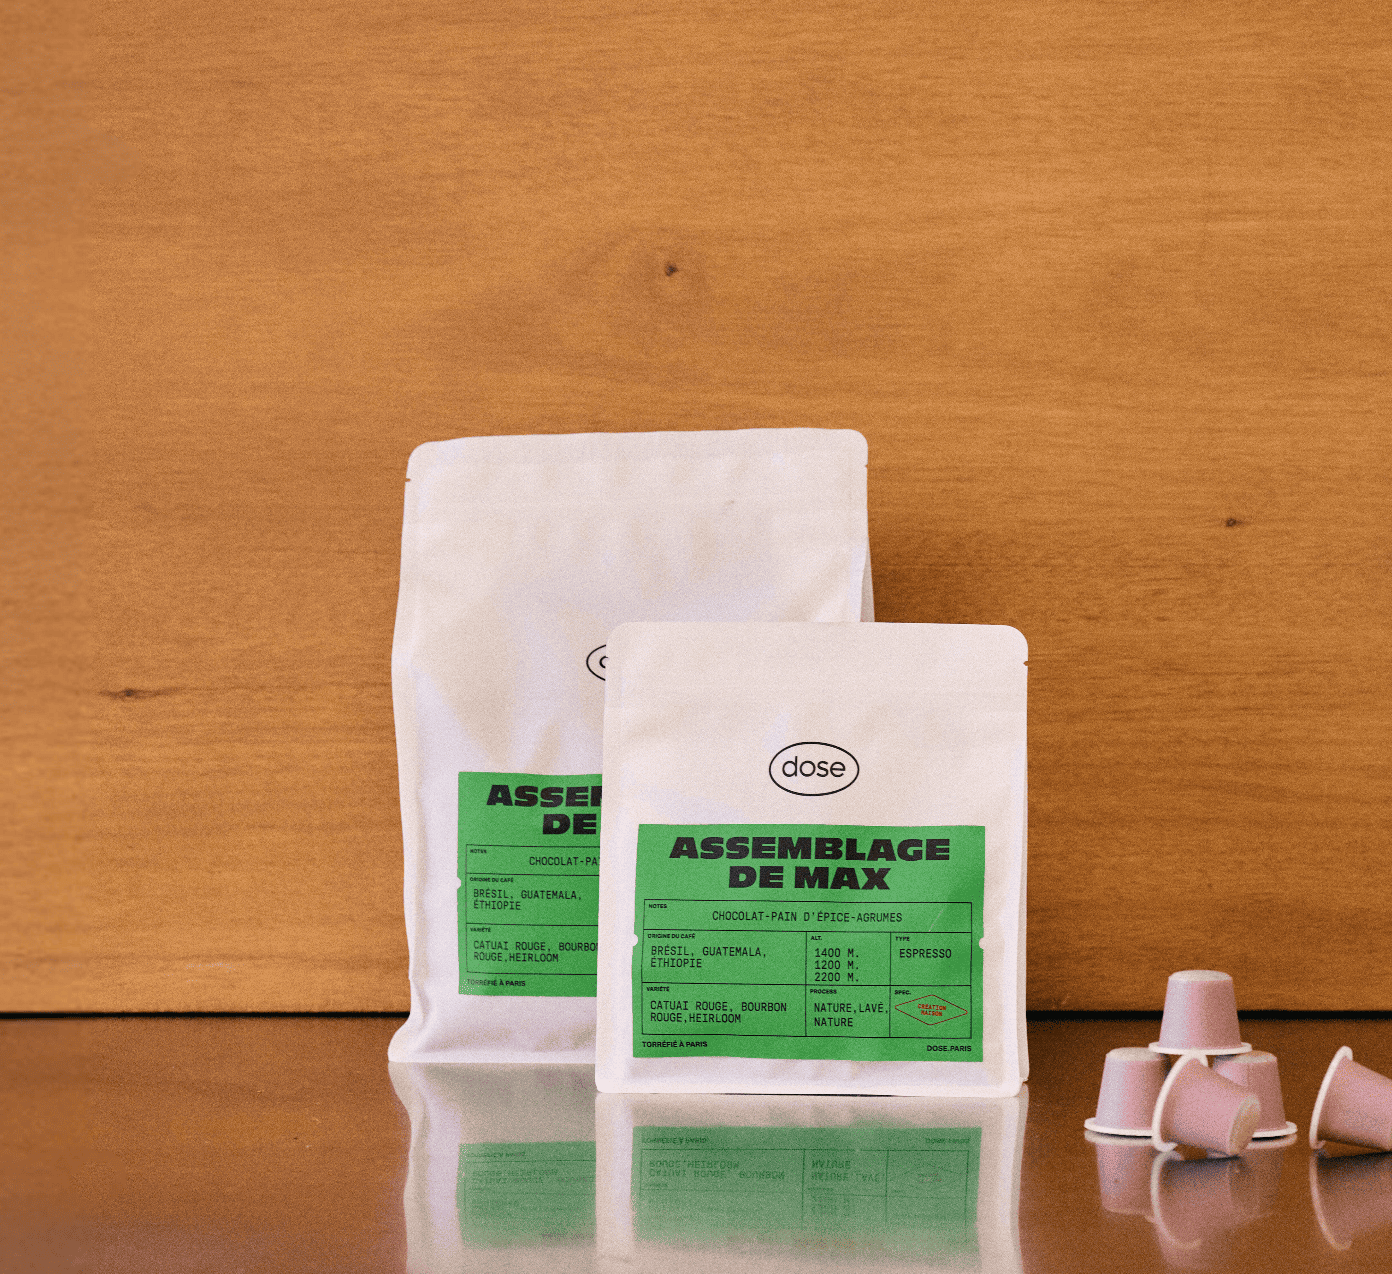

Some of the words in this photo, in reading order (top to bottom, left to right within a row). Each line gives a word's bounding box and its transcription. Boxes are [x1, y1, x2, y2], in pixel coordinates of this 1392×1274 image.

[781, 756, 846, 778] dose
[543, 813, 597, 835] DE
[669, 837, 951, 861] ASSEMBLAGE
[728, 865, 784, 889] DE
[794, 867, 891, 890] MAX
[521, 890, 582, 901] GUATEMALA,
[473, 900, 521, 911] ÉTHIOPIE
[712, 911, 797, 922] CHOCOLAT-PAIN
[803, 911, 903, 923] D'ÉPICE-AGRUMES
[473, 941, 509, 951] CATUAI
[515, 942, 552, 953] ROUGE,
[651, 945, 694, 957] BRÉSIL,
[702, 946, 766, 959] GUATEMALA,
[814, 948, 841, 958] 1400
[847, 948, 859, 958] M.
[899, 948, 952, 959] ESPRESSO
[650, 957, 702, 968] ÉTHIOPIE
[814, 960, 841, 970] 1200
[847, 960, 859, 970] M.
[814, 972, 841, 982] 2200
[847, 972, 859, 982] M.
[650, 1000, 689, 1011] CATUAI
[695, 1001, 733, 1013] ROUGE,
[741, 1002, 787, 1012] BOURBON
[814, 1017, 854, 1027] NATURE
[679, 1039, 685, 1047] À
